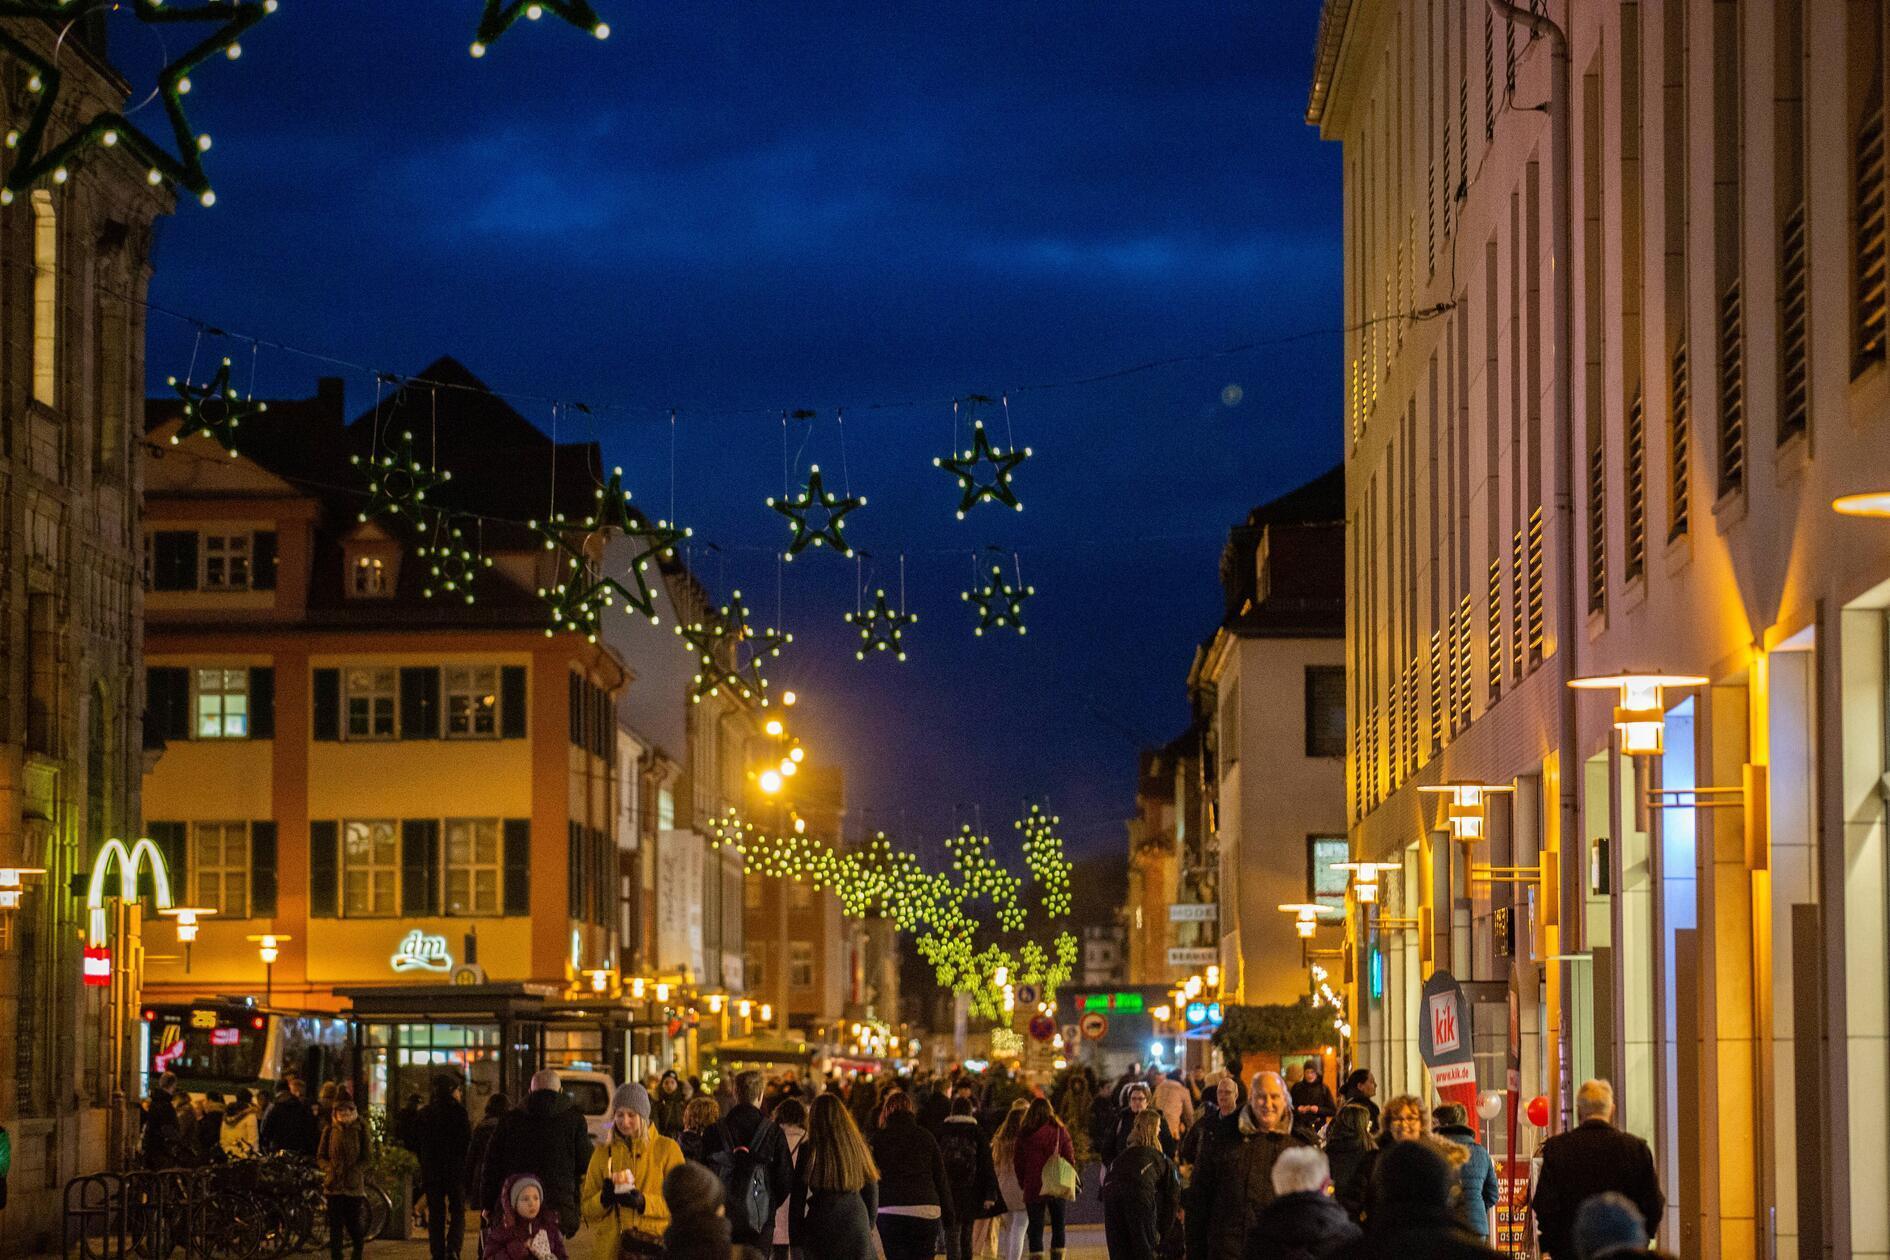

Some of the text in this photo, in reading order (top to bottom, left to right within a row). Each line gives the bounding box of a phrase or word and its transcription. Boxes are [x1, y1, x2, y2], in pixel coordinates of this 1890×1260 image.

[398, 929, 448, 961] dm
[1434, 1005, 1455, 1045] kik
[1435, 1067, 1469, 1082] www.kik.de
